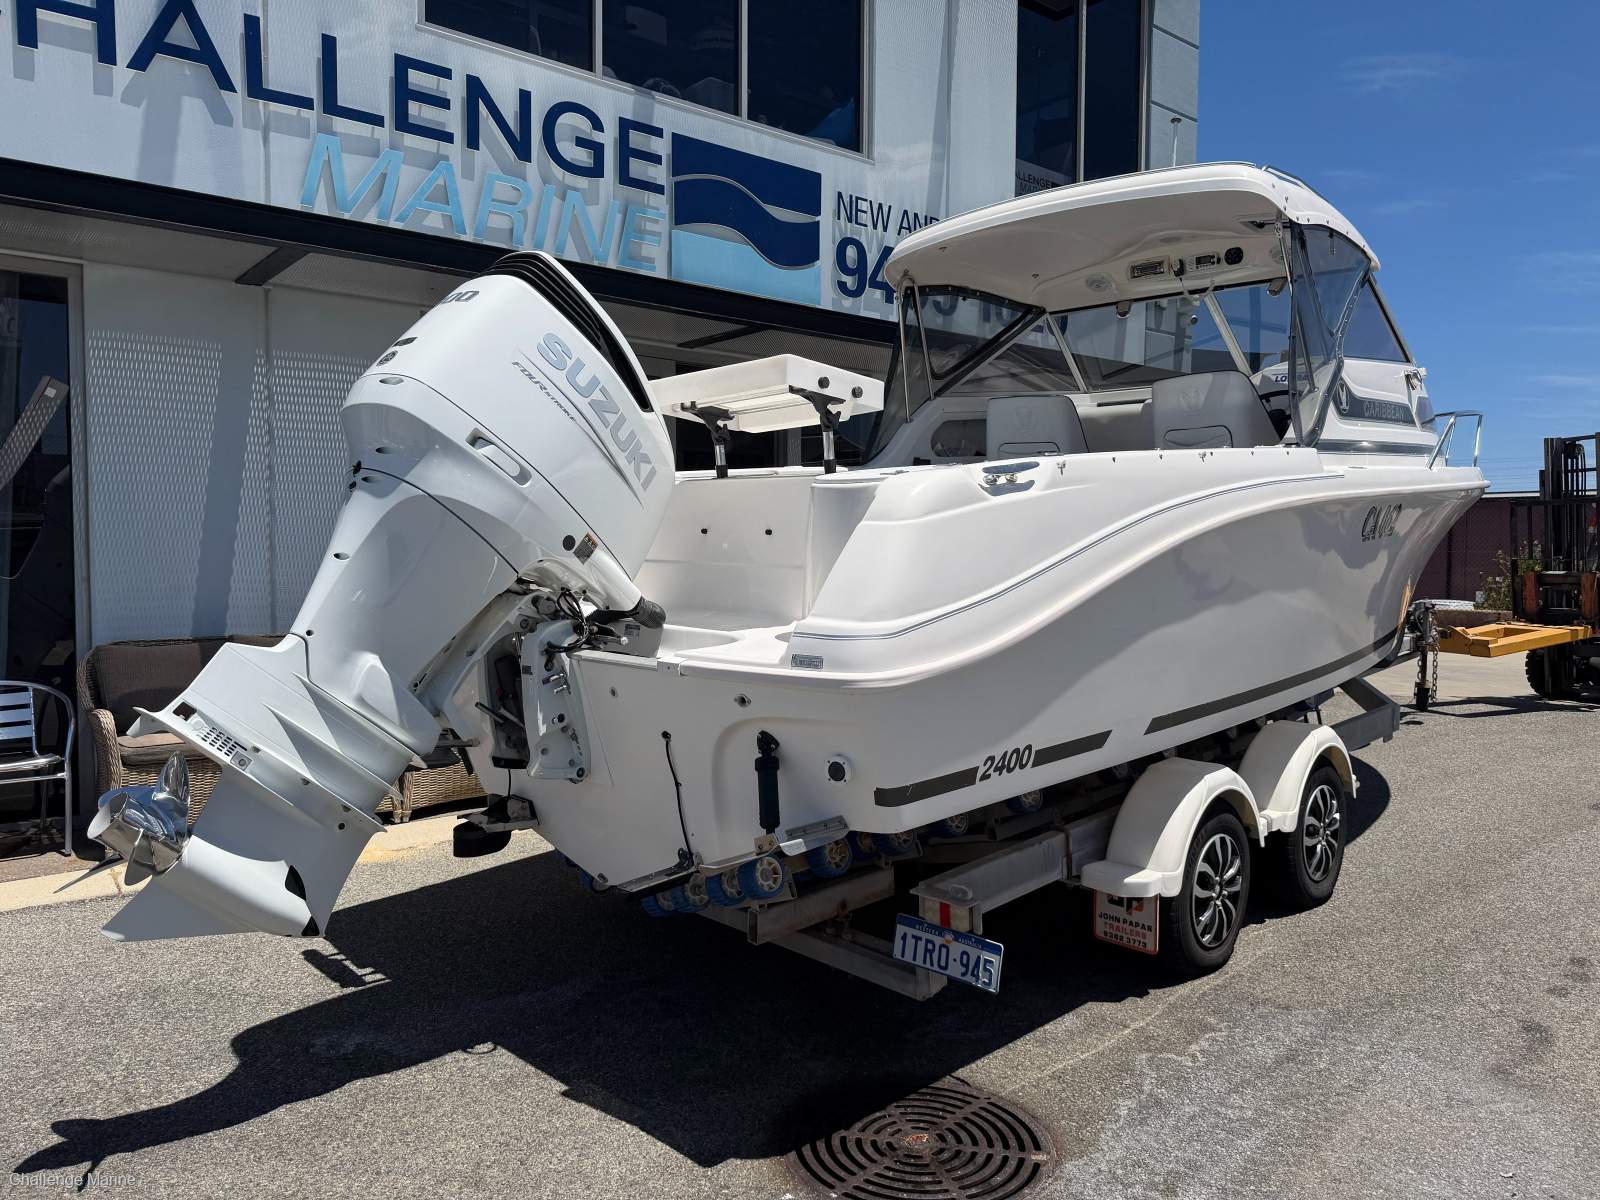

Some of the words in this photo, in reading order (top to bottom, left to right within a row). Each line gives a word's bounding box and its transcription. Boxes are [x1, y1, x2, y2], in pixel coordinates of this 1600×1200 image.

[0, 0, 665, 196] HALLENGE
[301, 135, 667, 272] MARINE
[837, 191, 892, 233] NEW
[536, 332, 656, 492] SUZUKI
[978, 743, 1033, 782] 2400
[1098, 911, 1121, 924] JOHN
[1122, 918, 1153, 932] PAPAS
[1103, 921, 1148, 940] TRAILERS
